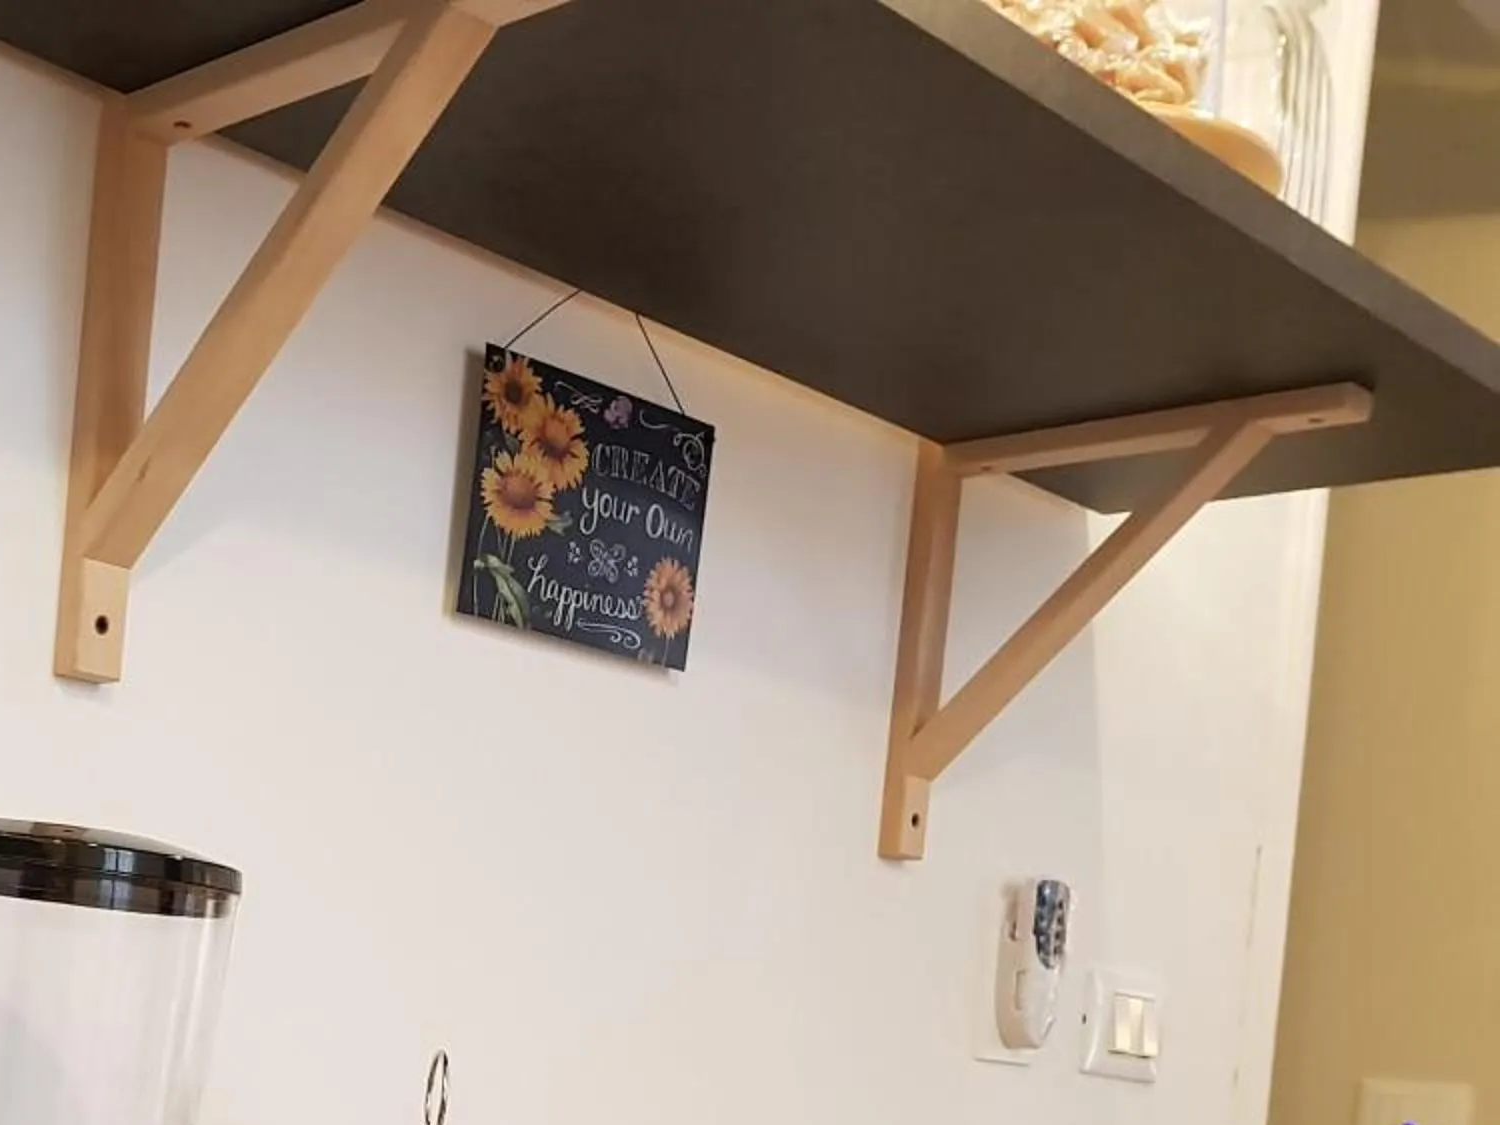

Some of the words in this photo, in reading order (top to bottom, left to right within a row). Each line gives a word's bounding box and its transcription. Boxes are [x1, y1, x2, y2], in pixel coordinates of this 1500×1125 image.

[591, 443, 702, 511] CREATE
[579, 487, 641, 535] your
[645, 503, 694, 552] Own
[527, 554, 643, 631] happiness
